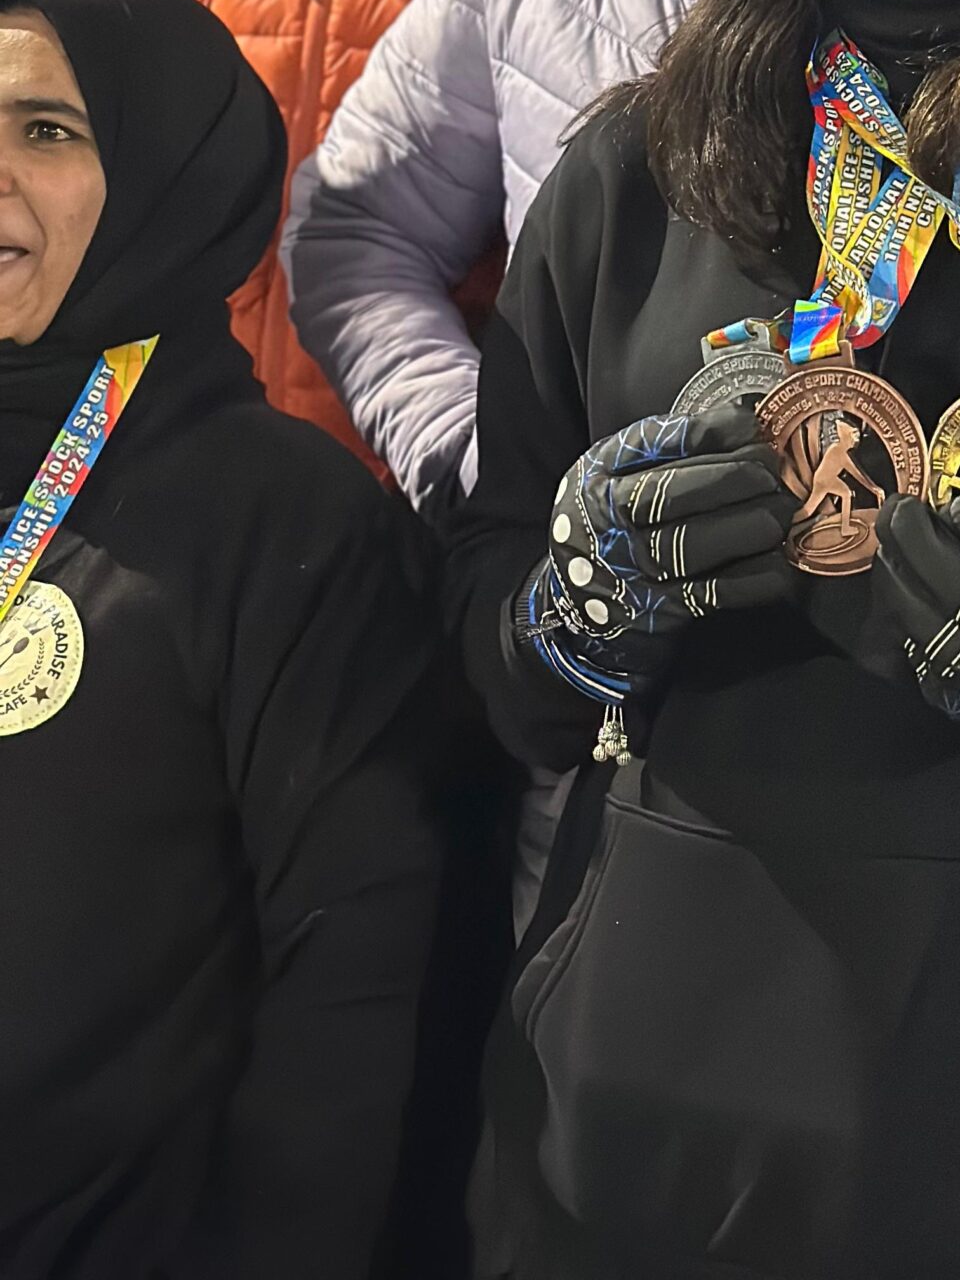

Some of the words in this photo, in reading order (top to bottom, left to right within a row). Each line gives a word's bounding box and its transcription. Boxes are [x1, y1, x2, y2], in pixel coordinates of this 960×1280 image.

[835, 51, 891, 119] 2024-25
[804, 372, 844, 390] SPORT
[846, 374, 917, 445] CHAMPIONSHIP
[856, 397, 896, 440] February
[890, 439, 906, 471] 2025
[16, 431, 79, 544] ICE-STOCK
[72, 364, 115, 431] SPORT
[54, 410, 110, 499] 2024-25
[43, 604, 69, 680] PARADISE
